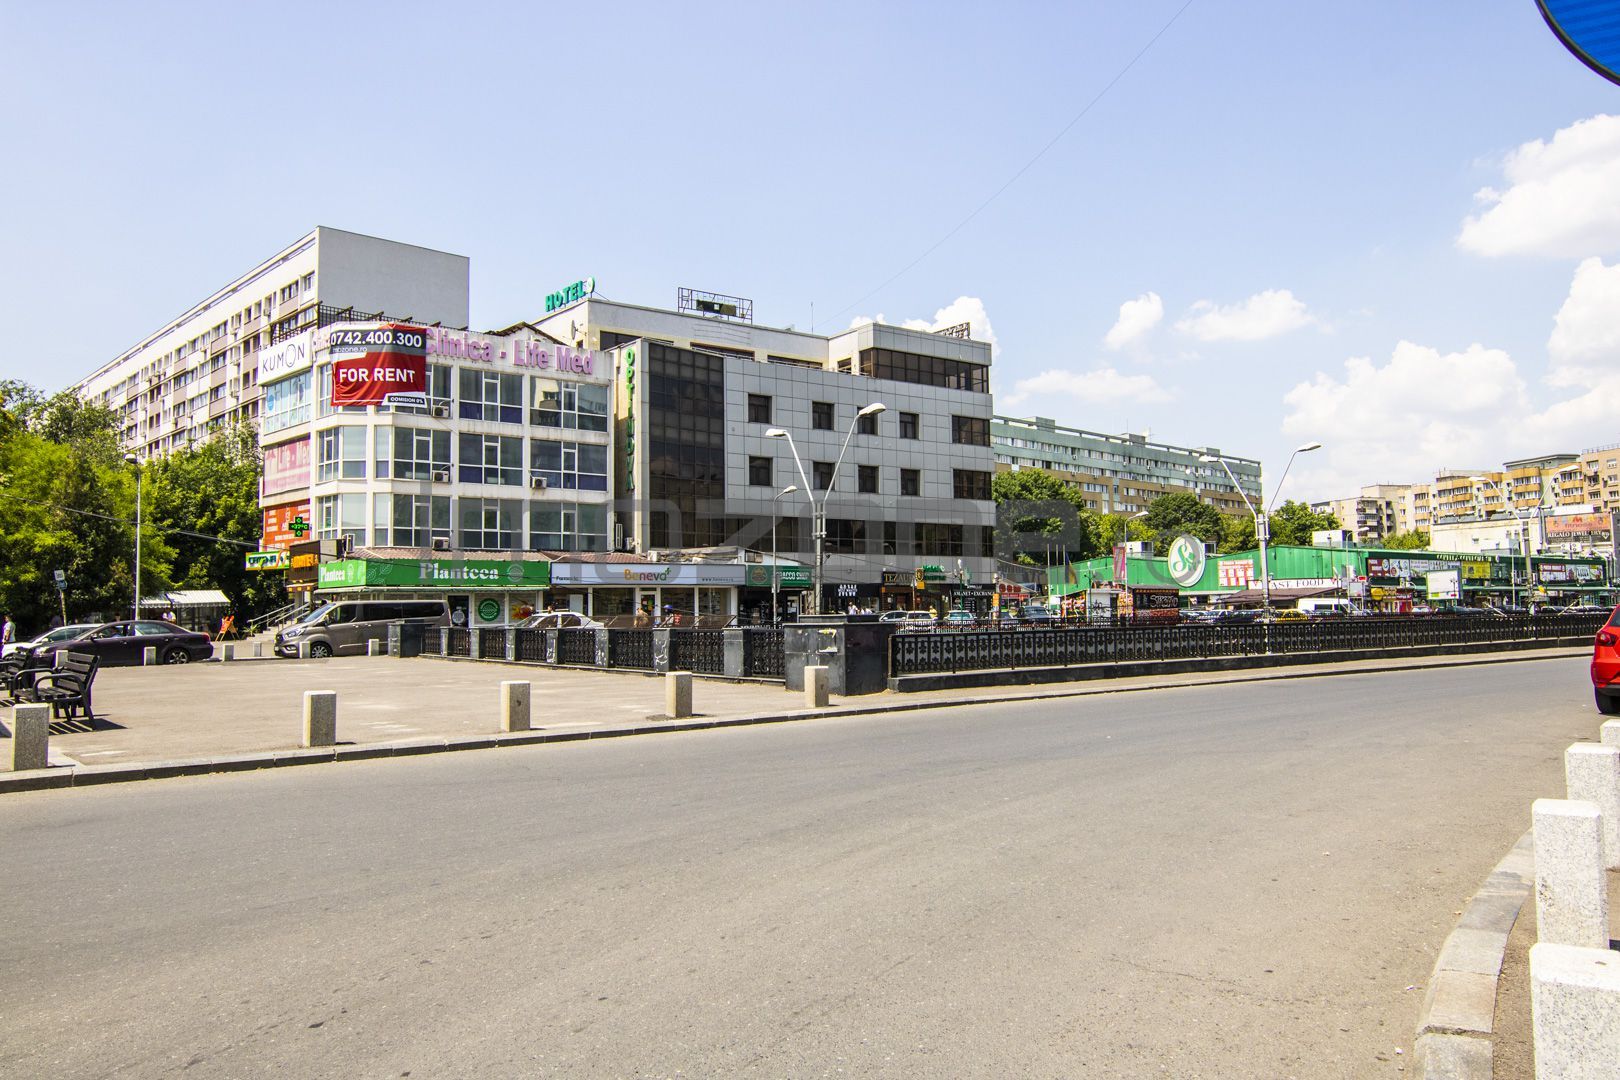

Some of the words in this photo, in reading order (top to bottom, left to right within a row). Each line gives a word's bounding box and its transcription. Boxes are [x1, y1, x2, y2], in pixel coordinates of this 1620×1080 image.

[545, 280, 586, 312] HOTEL
[331, 331, 422, 348] 0742.400.300
[262, 343, 305, 374] KUMON
[425, 328, 493, 362] Clinica
[512, 338, 548, 369] Life
[555, 345, 593, 375] Med
[339, 368, 369, 383] FOR
[374, 368, 416, 383] RENT
[624, 568, 667, 582] Beneva
[1296, 578, 1324, 588] FOOD
